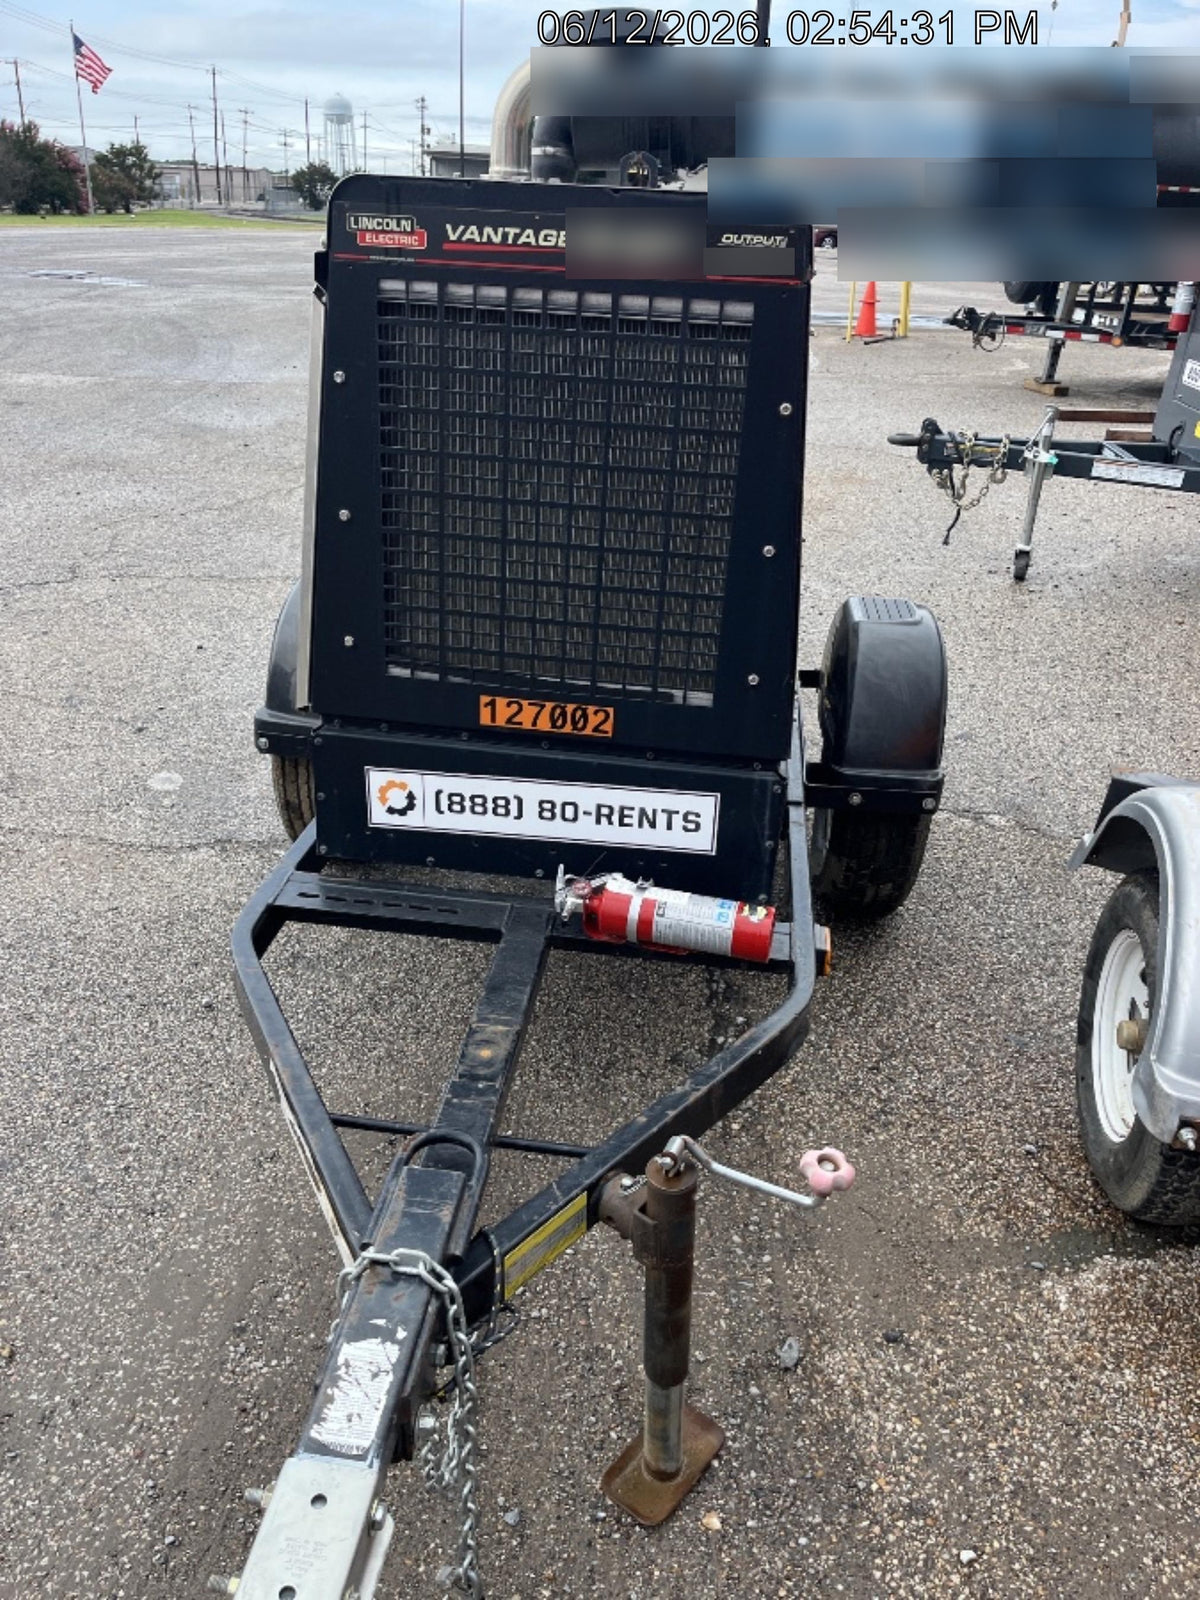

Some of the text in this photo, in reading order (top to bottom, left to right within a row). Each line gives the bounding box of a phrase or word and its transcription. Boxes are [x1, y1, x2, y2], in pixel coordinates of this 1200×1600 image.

[350, 216, 411, 232] LINCOLN
[365, 232, 419, 246] ELECTRIC
[720, 233, 786, 247] OUTPUT
[483, 697, 610, 734] 127002
[434, 789, 701, 833] (888) 80-RENTS
